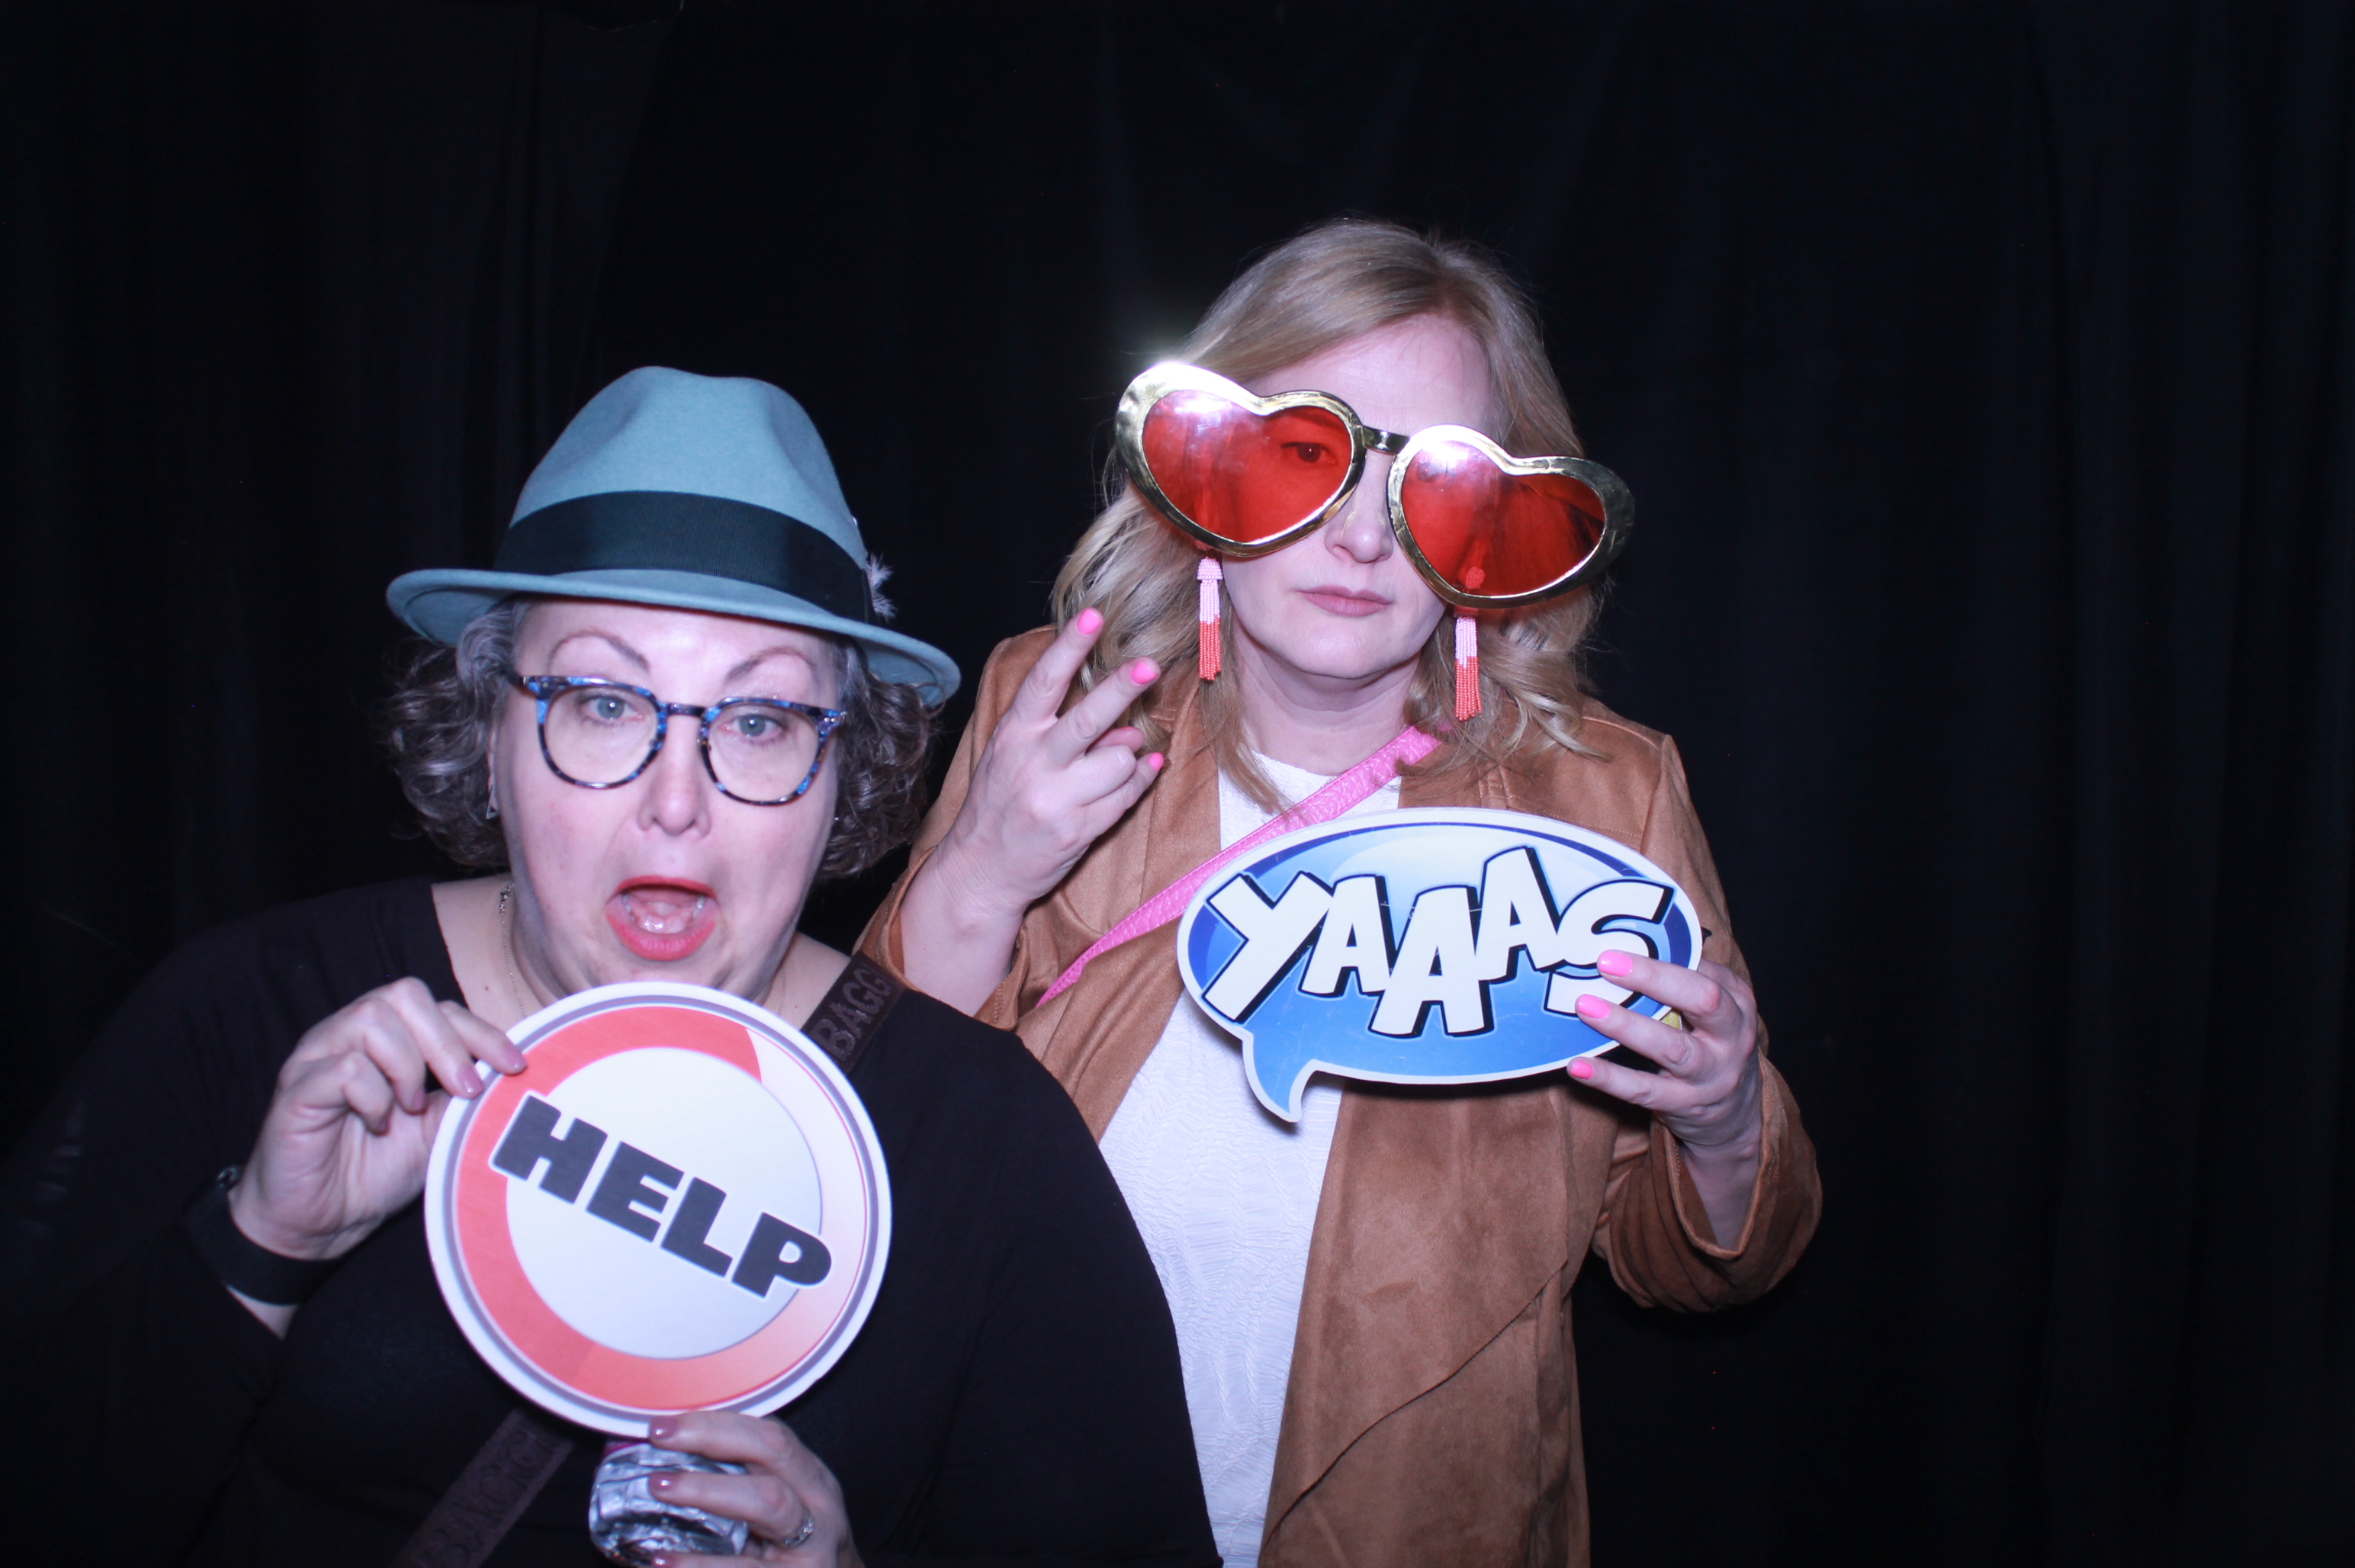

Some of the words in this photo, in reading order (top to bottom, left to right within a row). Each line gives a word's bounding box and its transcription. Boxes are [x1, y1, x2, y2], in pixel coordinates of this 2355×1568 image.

[810, 962, 894, 1061] BAGG
[1203, 845, 1674, 1038] YAAAS
[491, 1095, 832, 1299] HELP
